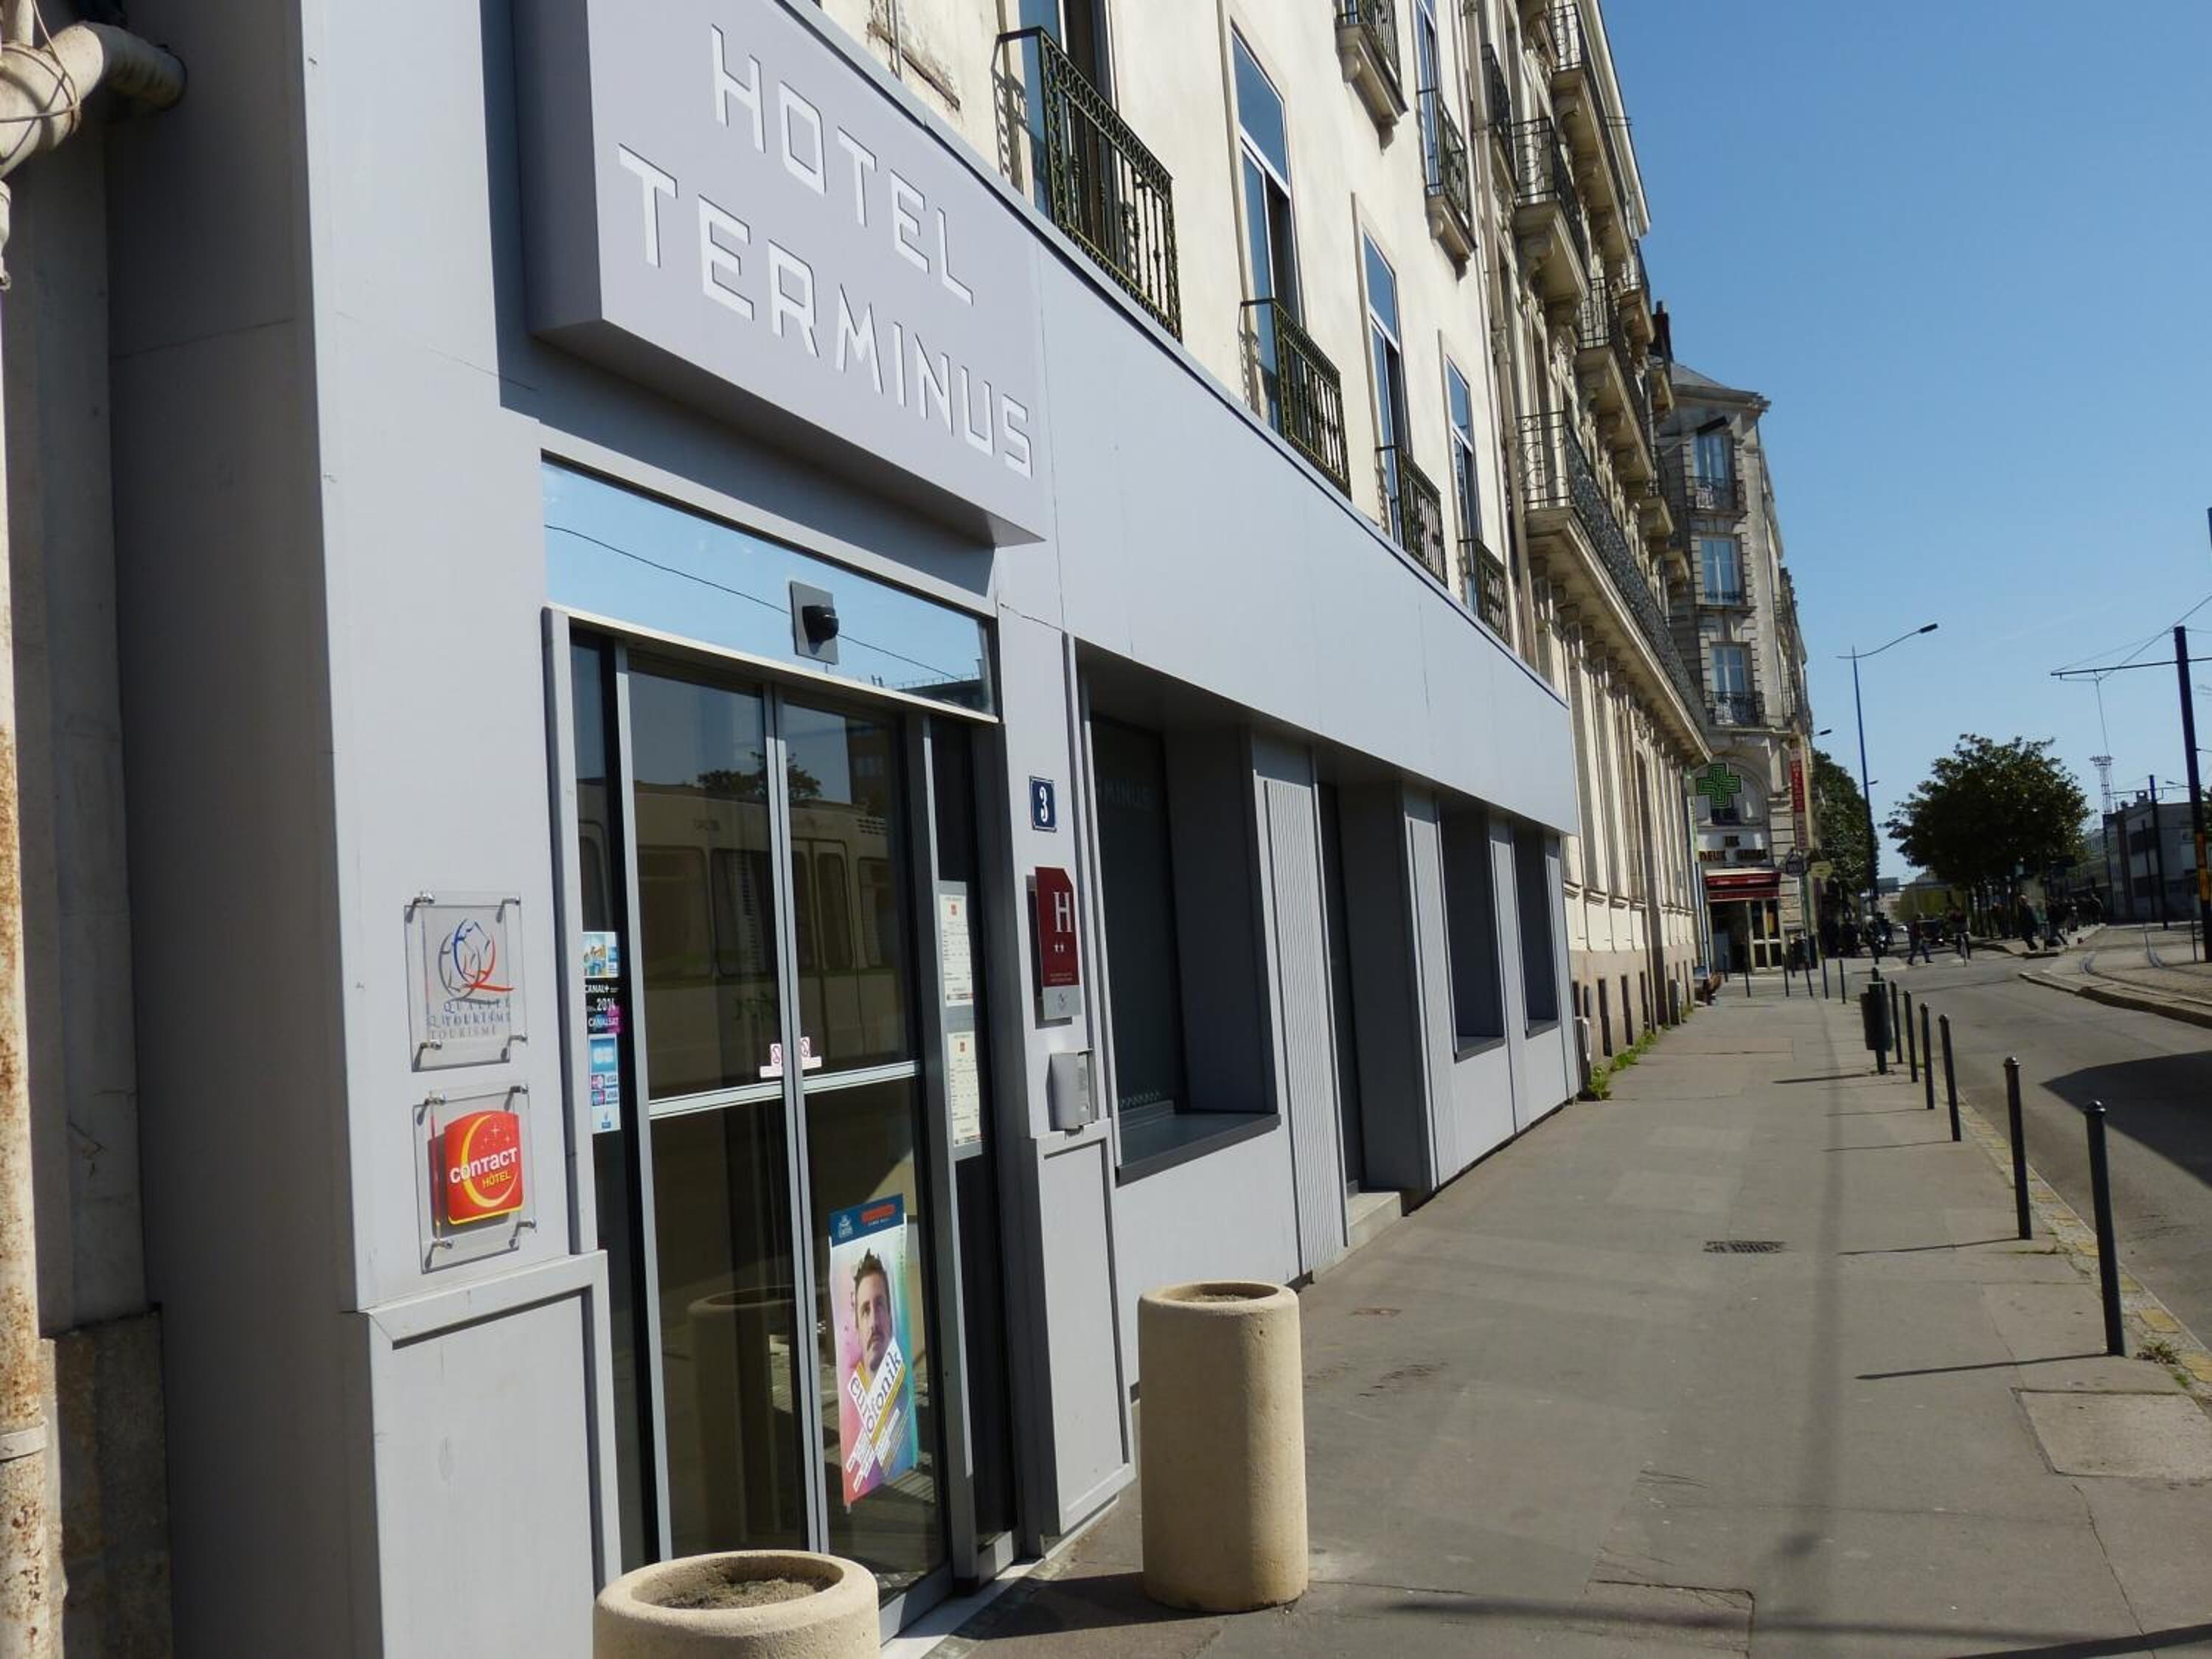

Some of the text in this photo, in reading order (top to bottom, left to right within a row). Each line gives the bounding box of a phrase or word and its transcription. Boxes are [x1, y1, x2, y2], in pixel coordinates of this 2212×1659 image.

[712, 23, 973, 307] HOTEL
[618, 142, 1033, 480] TERMINUS
[1039, 785, 1049, 823] 3
[1054, 891, 1074, 933] H
